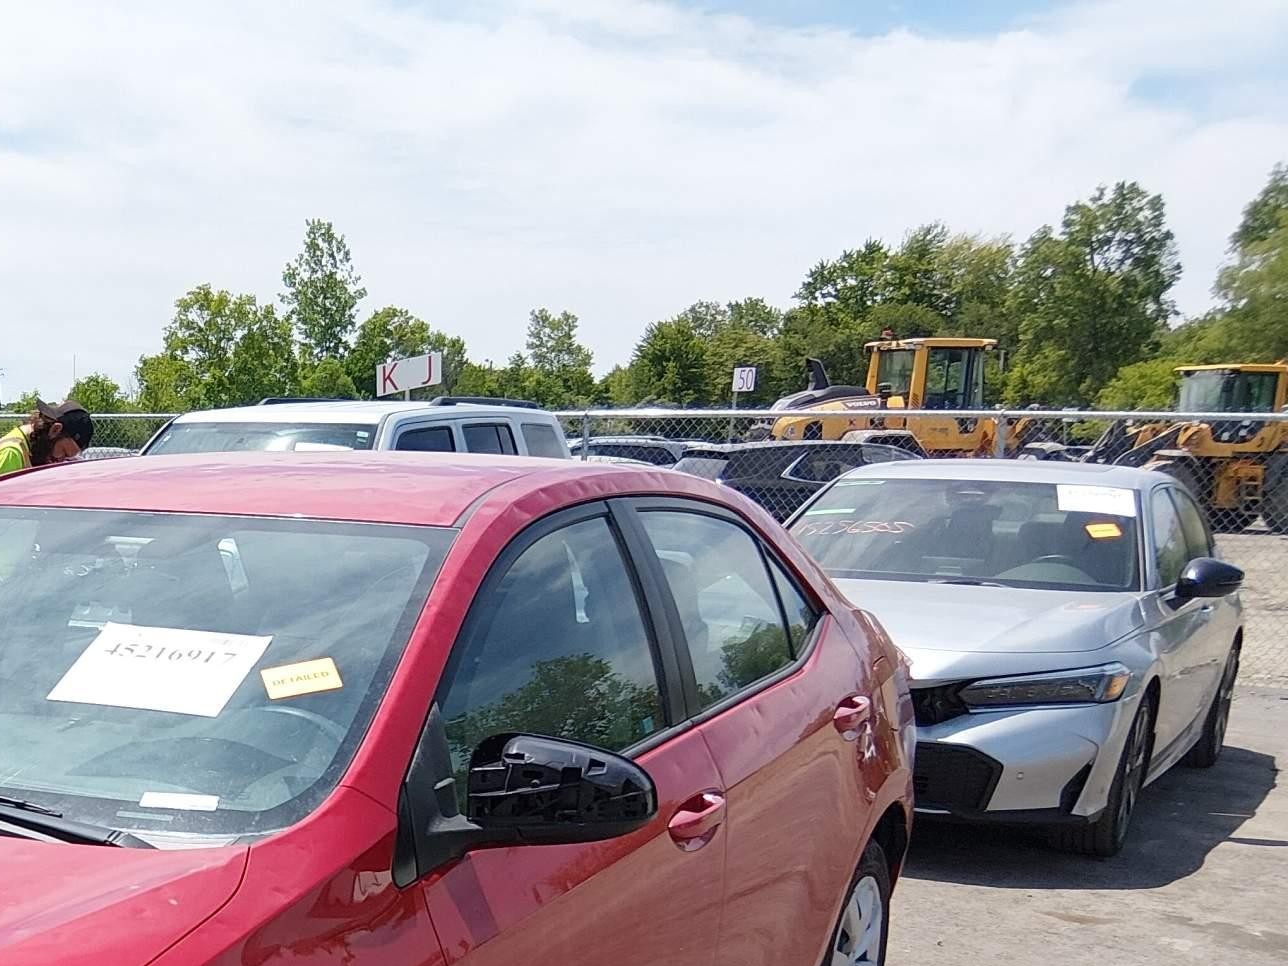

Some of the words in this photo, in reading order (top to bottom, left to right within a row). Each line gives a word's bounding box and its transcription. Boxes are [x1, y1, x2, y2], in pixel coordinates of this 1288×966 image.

[382, 362, 399, 394] K
[421, 355, 432, 385] J
[737, 369, 754, 390] 50
[103, 643, 238, 664] 45216917
[272, 671, 330, 687] DETAILED
